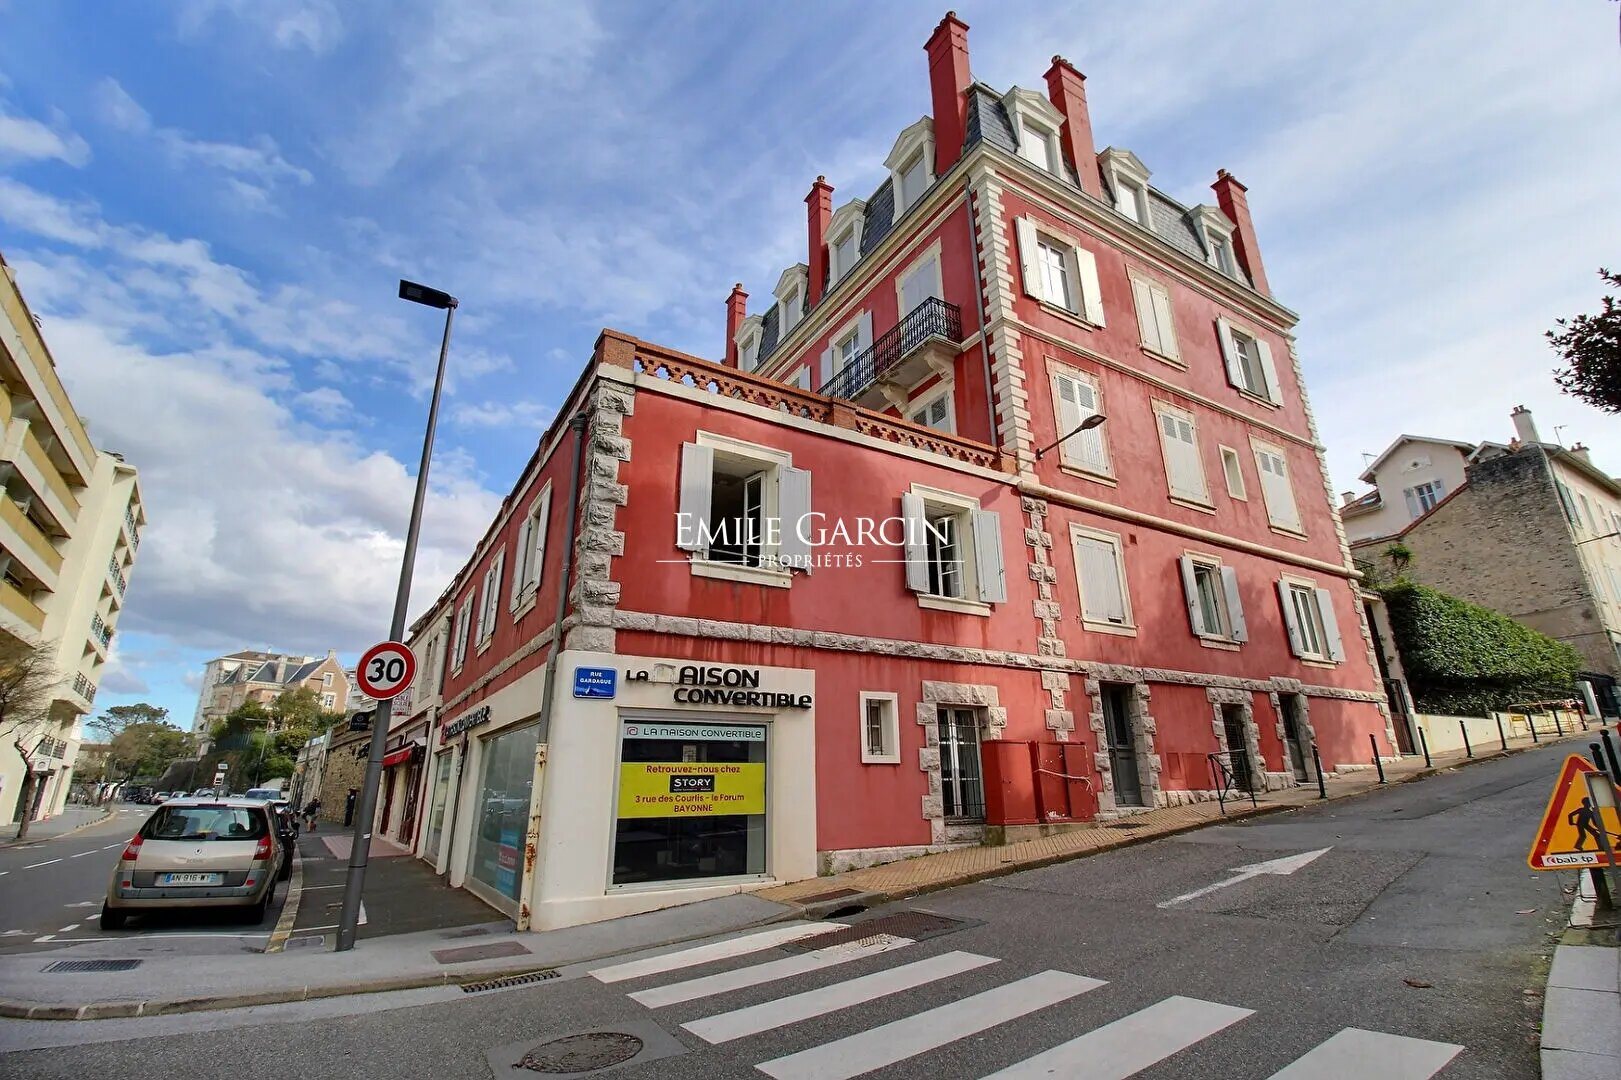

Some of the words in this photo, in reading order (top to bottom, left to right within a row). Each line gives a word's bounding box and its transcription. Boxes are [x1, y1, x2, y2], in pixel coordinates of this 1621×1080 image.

[367, 658, 405, 683] 30
[643, 728, 657, 736] LA
[646, 765, 719, 773] Retrouvez-nous
[720, 765, 740, 773] chez
[673, 778, 711, 787] STORY
[635, 795, 641, 803] 3
[658, 795, 673, 803] des
[673, 804, 713, 812] BAYONNE
[1556, 856, 1578, 864] bab
[1581, 855, 1594, 863] tp
